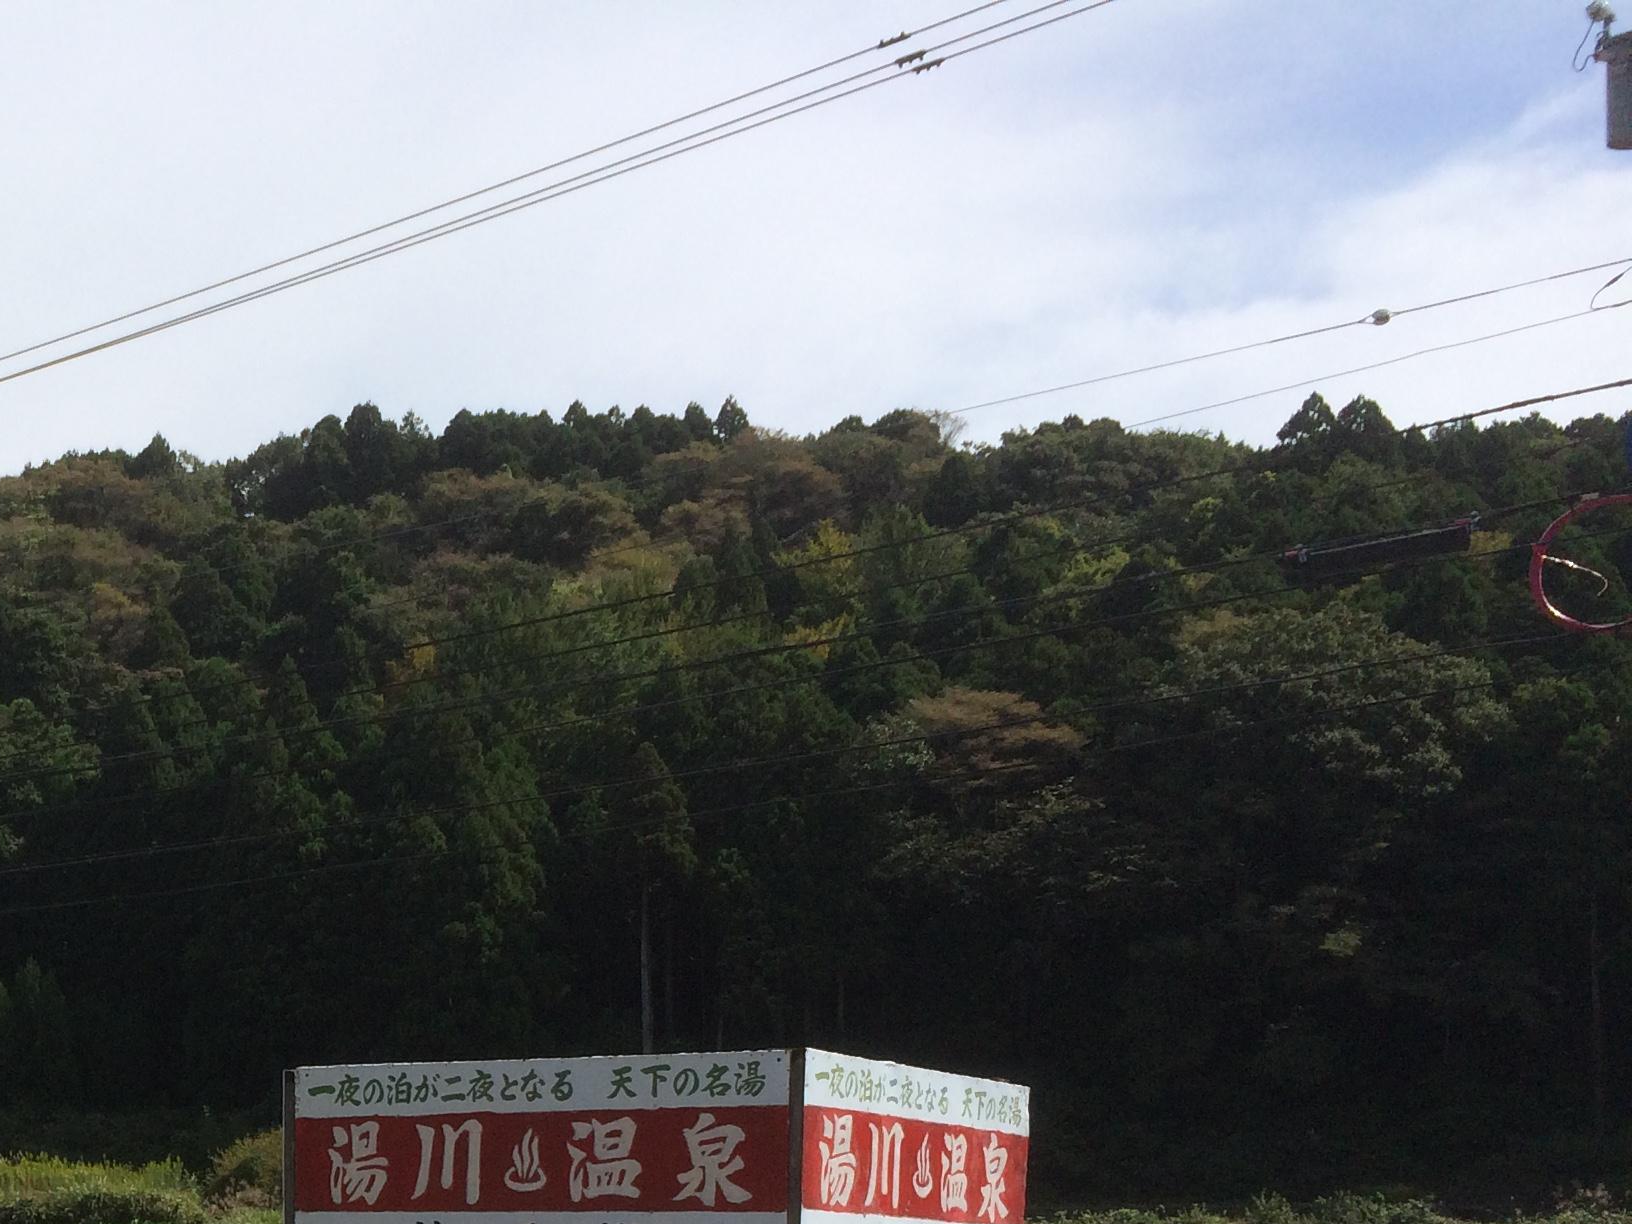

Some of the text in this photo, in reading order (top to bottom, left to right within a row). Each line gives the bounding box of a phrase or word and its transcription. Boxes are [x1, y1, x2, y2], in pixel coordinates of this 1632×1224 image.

[308, 1061, 768, 1107] 一夜の泊が二夜となる 天下の名湯
[815, 1064, 1023, 1128] 一夜の泊が二夜となる 天下の名湯
